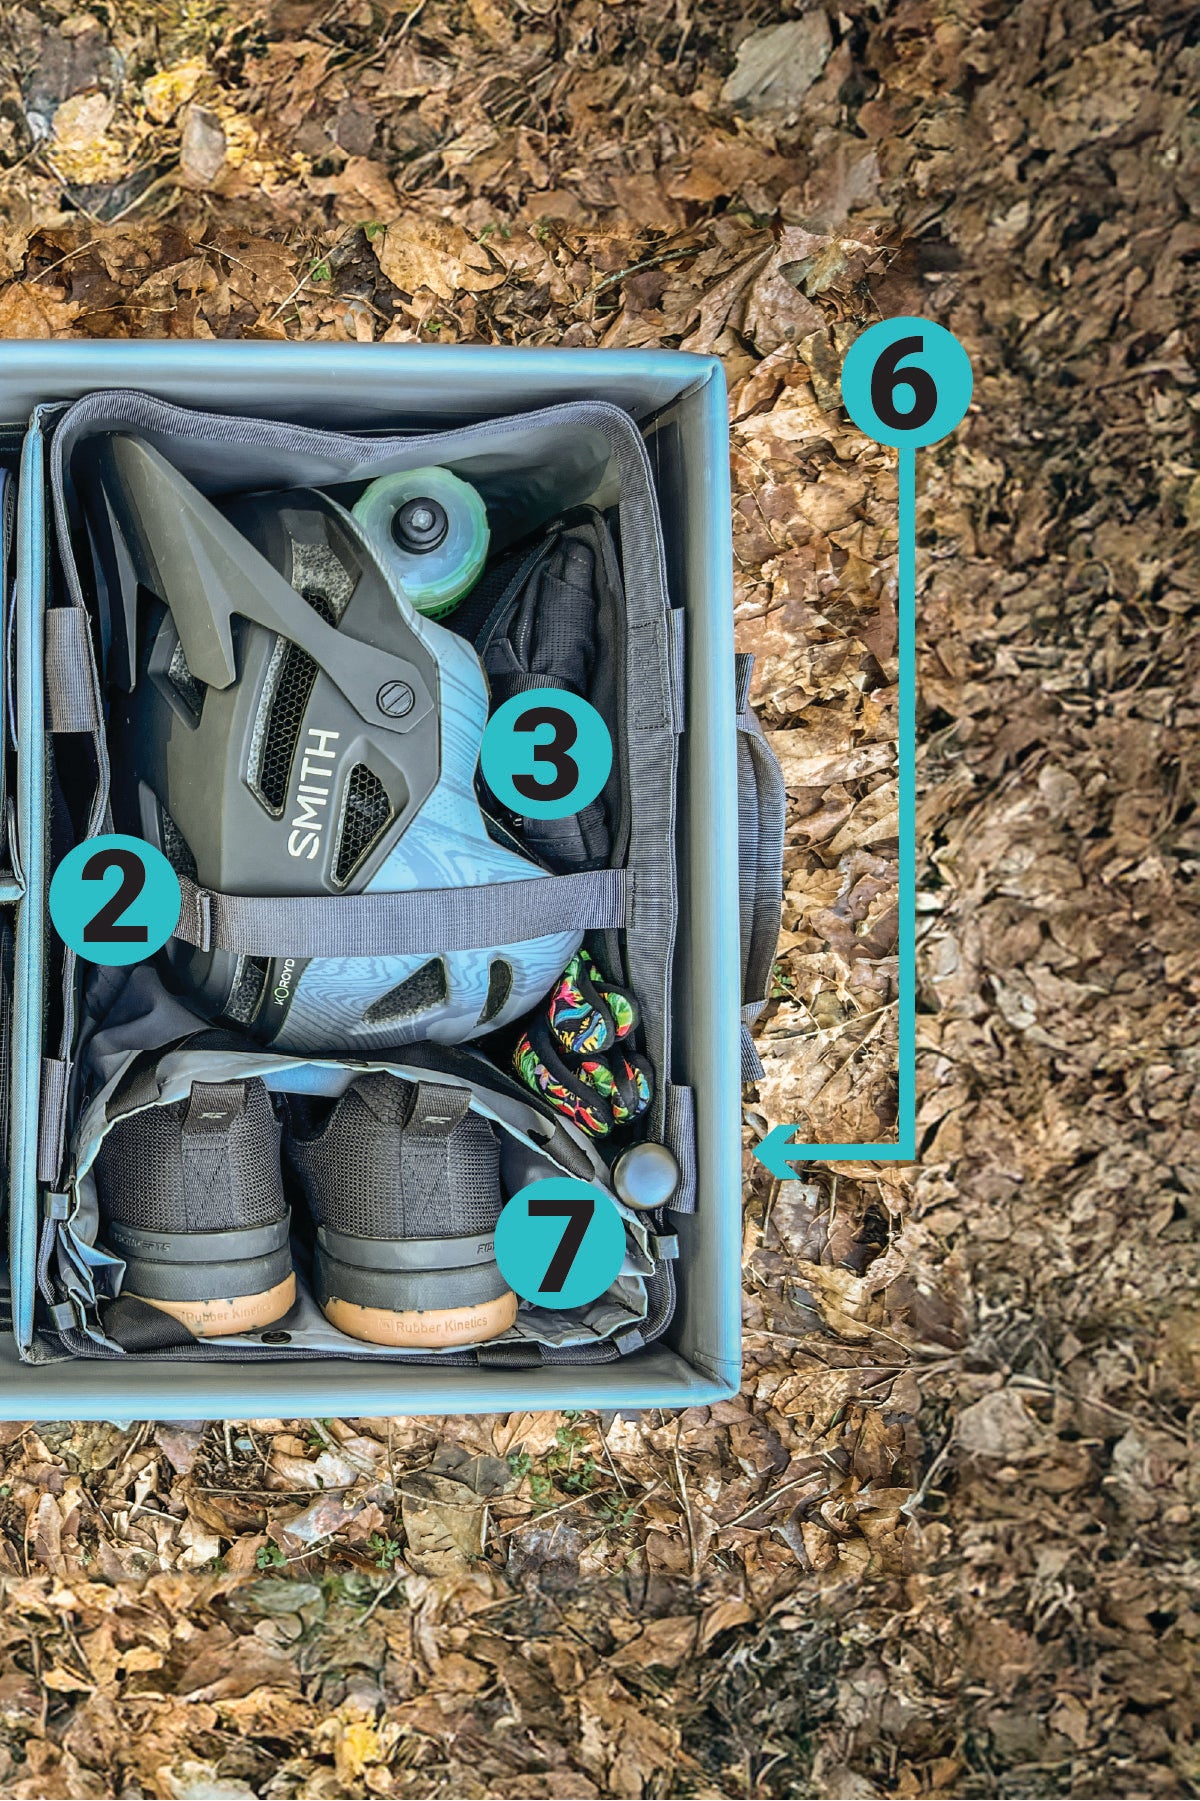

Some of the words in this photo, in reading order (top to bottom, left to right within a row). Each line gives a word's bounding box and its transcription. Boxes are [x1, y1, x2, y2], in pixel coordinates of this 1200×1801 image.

[287, 728, 340, 860] SMITH
[273, 958, 295, 1006] KOROYD
[185, 1309, 228, 1323] Rubber
[395, 1320, 442, 1334] Rubber
[444, 1315, 489, 1332] Kinetics
